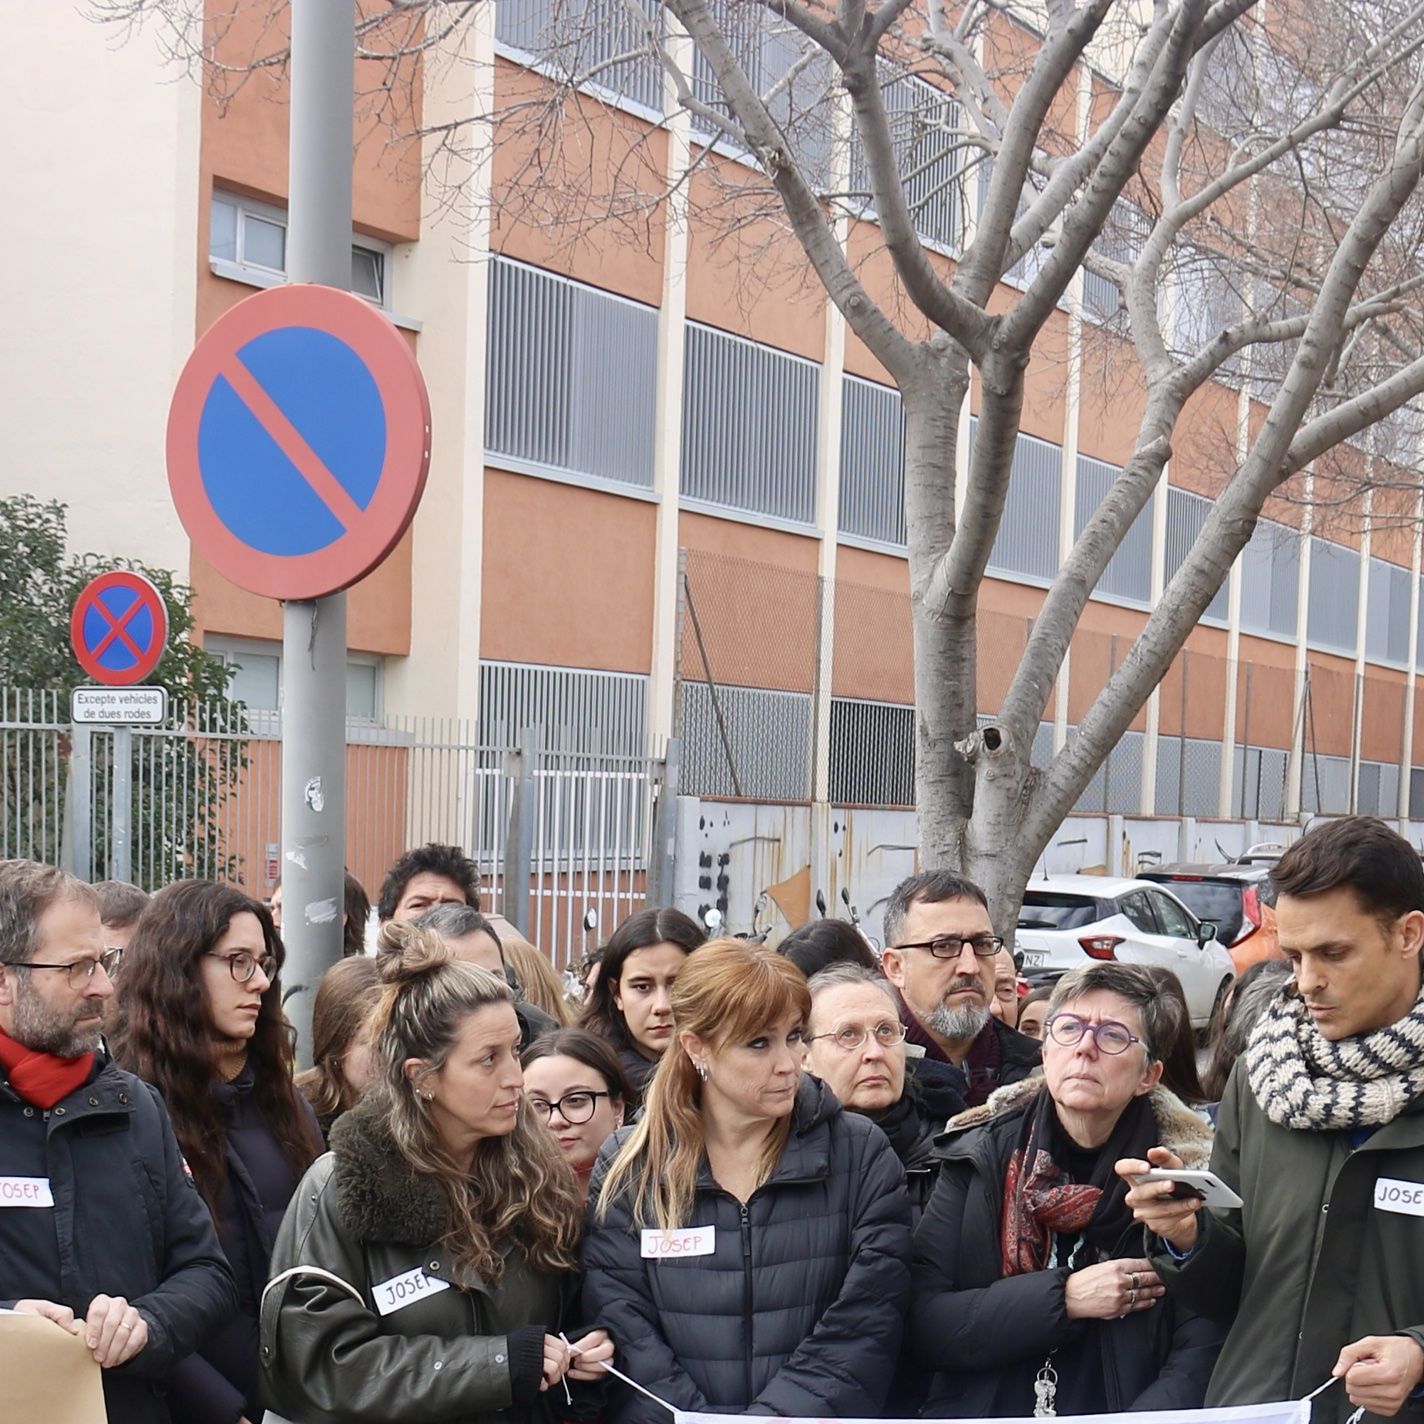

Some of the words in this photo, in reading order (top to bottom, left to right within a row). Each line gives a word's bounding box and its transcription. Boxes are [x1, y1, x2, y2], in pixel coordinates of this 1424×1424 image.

[78, 693, 117, 706] Excepte
[119, 692, 158, 705] vehicles
[83, 708, 96, 719] de
[98, 708, 122, 719] dues
[125, 708, 152, 719] rodes
[1025, 954, 1041, 967] NZ
